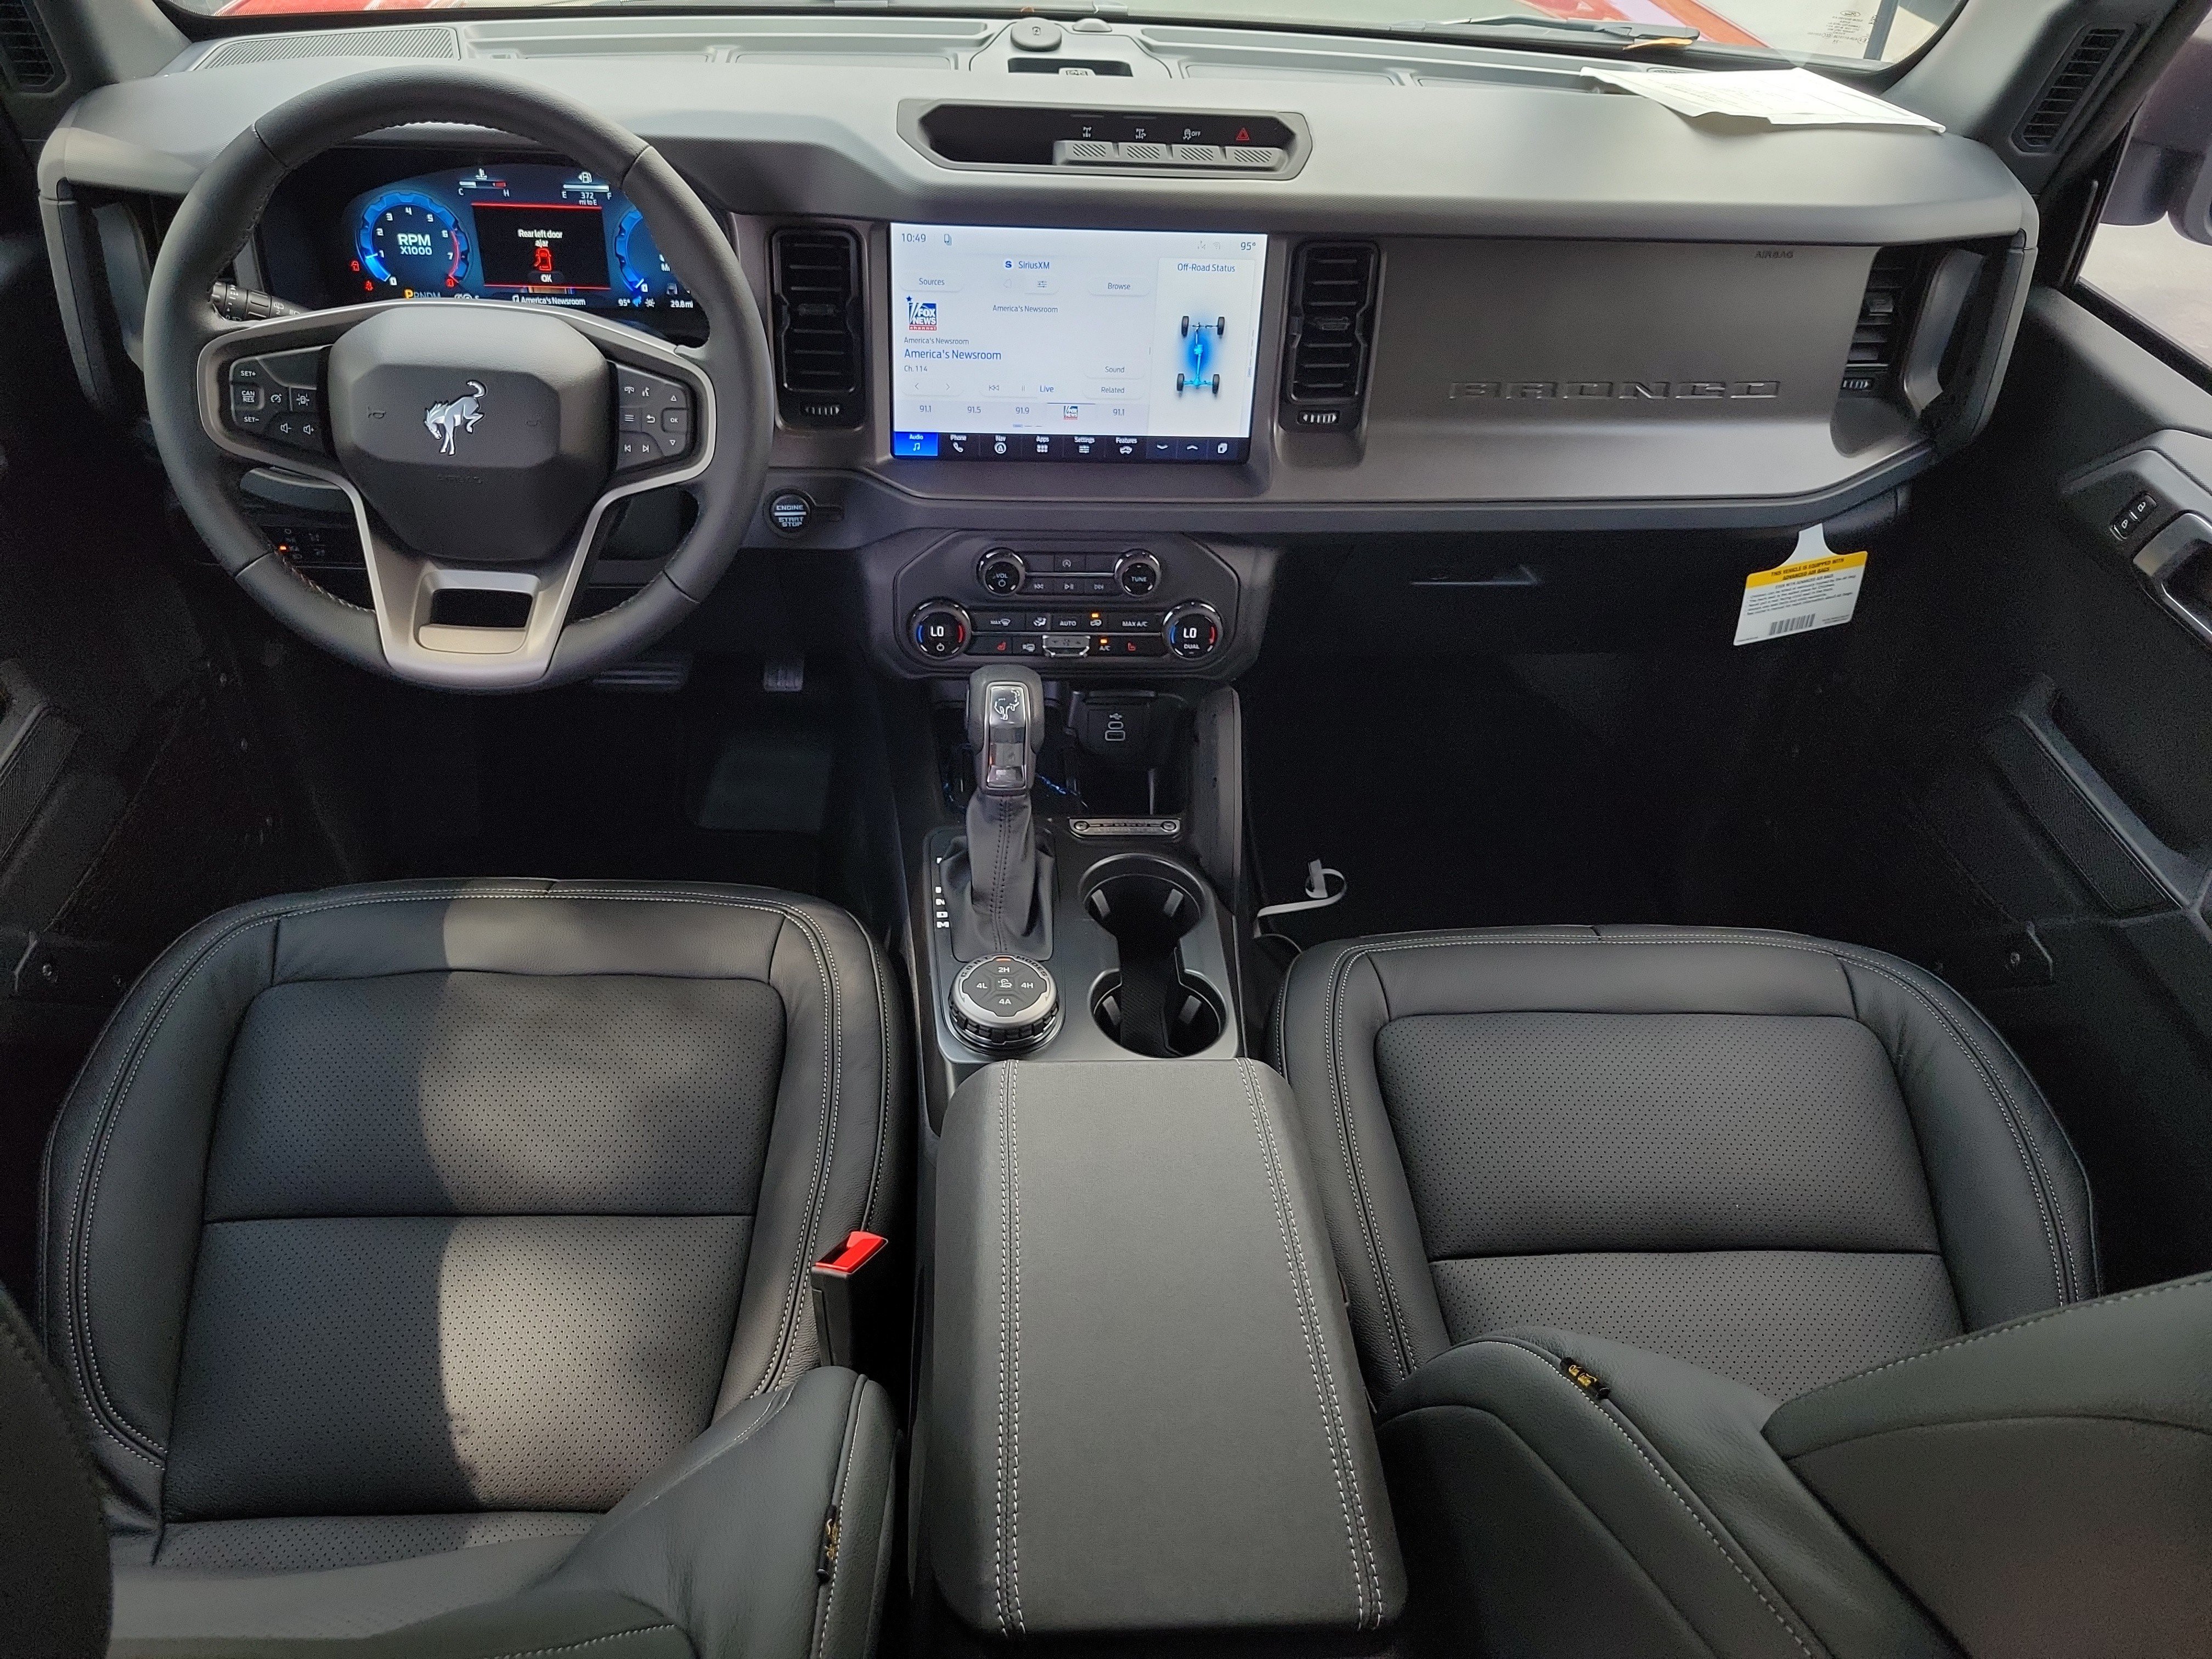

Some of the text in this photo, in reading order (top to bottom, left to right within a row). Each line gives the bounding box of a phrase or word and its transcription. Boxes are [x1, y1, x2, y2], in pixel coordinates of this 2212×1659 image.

[503, 189, 510, 197] H
[405, 207, 412, 215] 4
[386, 212, 393, 221] 3
[427, 213, 433, 222] 5
[376, 228, 383, 236] 2
[441, 230, 448, 238] 6
[517, 229, 563, 239] Rear left door
[397, 233, 431, 246] RPM
[901, 233, 927, 242] 10:49
[535, 239, 549, 248] ajar
[1240, 241, 1256, 250] 95°
[379, 250, 385, 258] 1
[400, 246, 432, 255] X1000
[447, 252, 454, 260] 7
[1018, 261, 1050, 269] SiriusXM
[1177, 263, 1235, 272] Off-Road Status
[390, 276, 397, 286] 0
[540, 274, 552, 283] OK
[918, 278, 945, 286] Sources
[641, 283, 648, 292] 0
[521, 296, 586, 306] America's Newsroom
[918, 308, 936, 317] FOX
[992, 304, 1024, 313] America's
[904, 349, 1001, 360] America's Newsroom
[1040, 385, 1054, 393] Live
[1449, 381, 1781, 399] BRONCO
[930, 625, 944, 637] LO
[1183, 628, 1197, 639] LO
[1017, 956, 1047, 976] MODES
